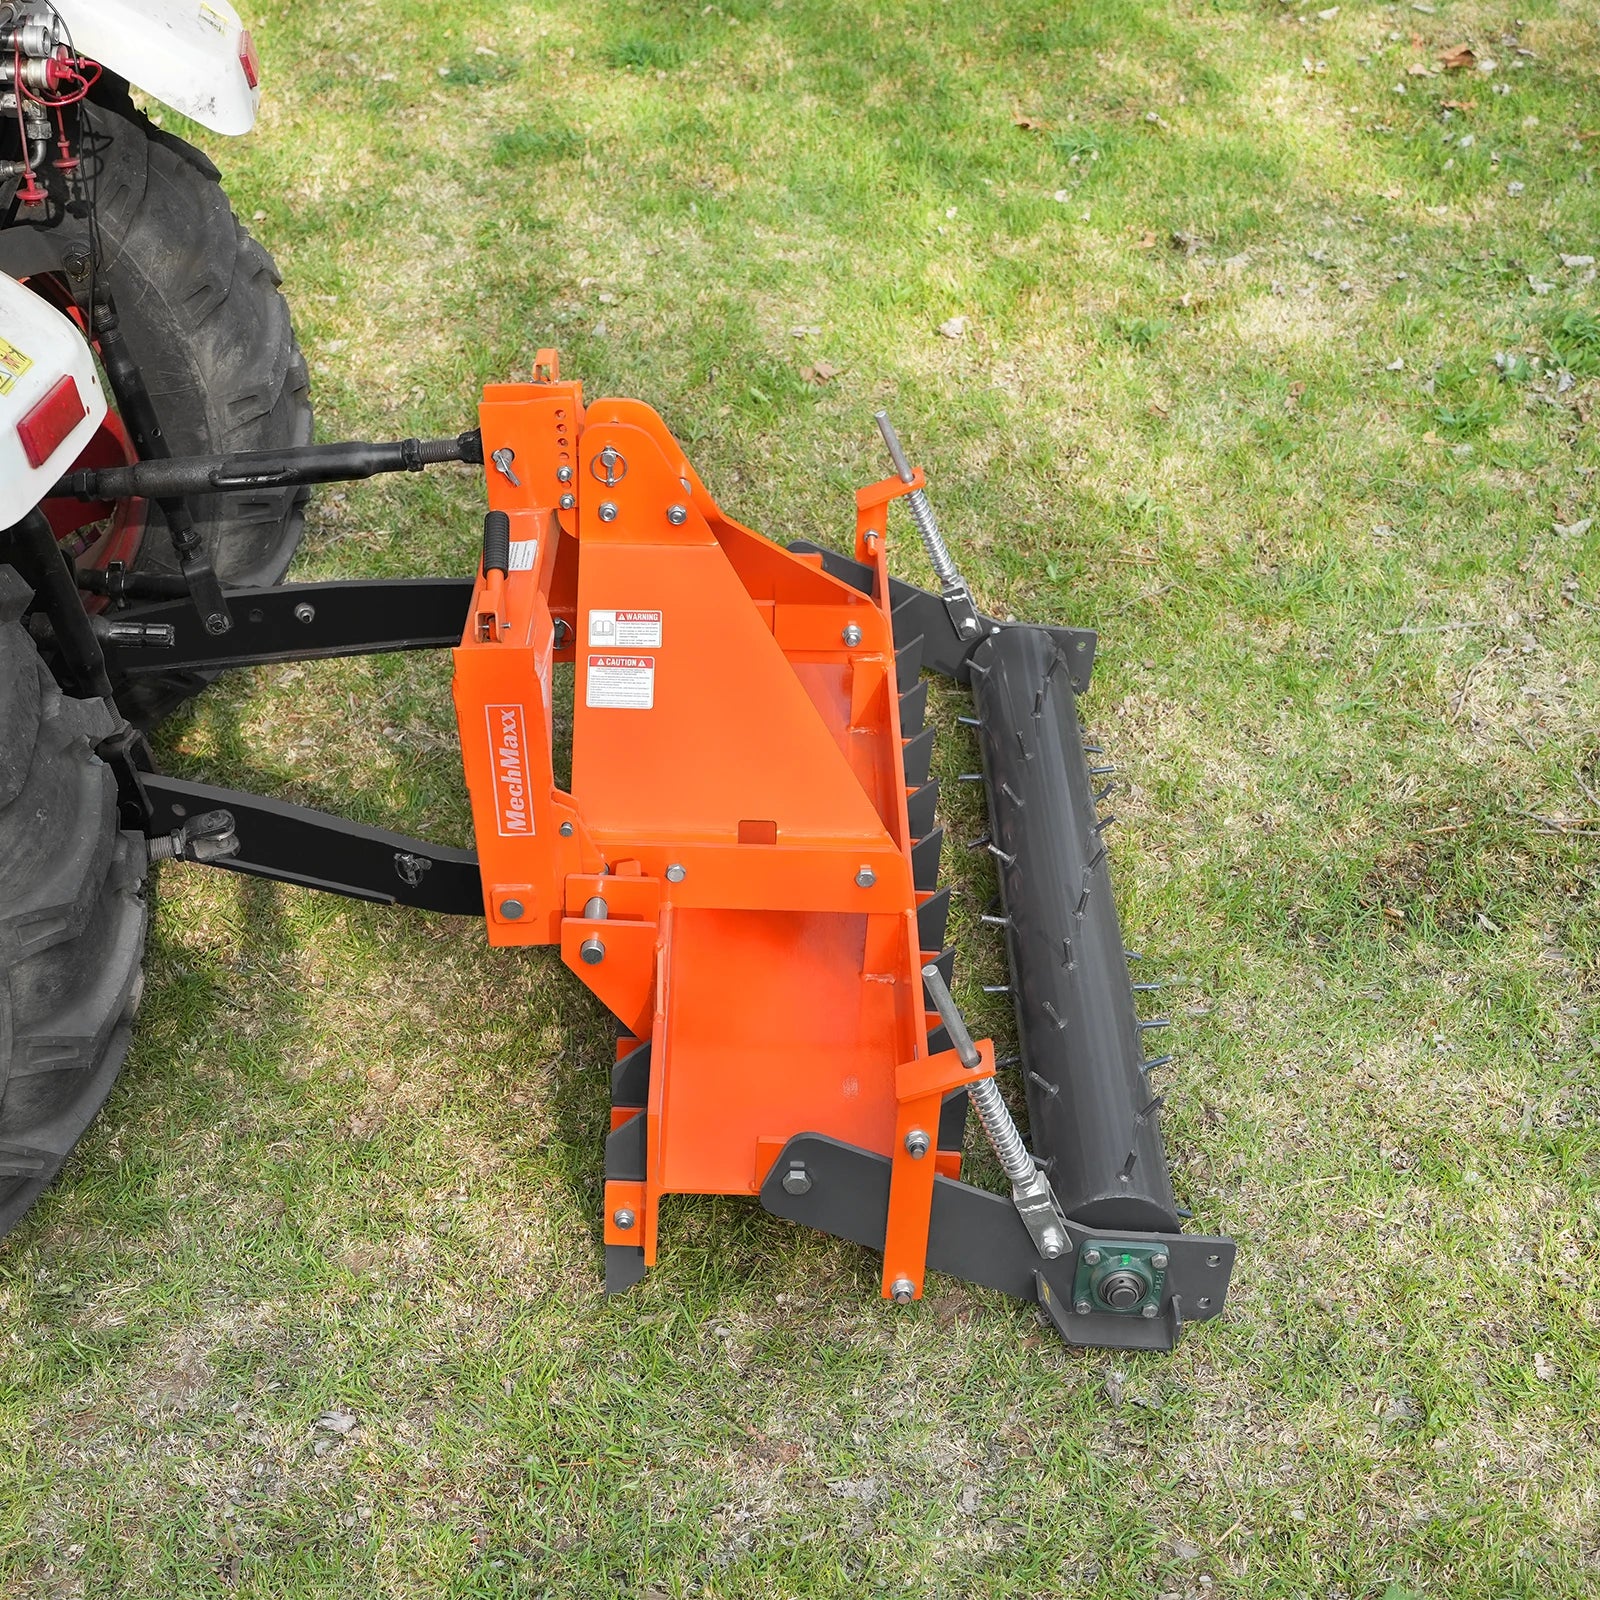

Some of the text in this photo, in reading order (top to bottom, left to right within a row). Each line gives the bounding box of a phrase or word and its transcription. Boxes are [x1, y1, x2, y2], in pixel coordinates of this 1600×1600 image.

[626, 613, 659, 621] WARNING
[606, 658, 637, 667] CAUTION
[498, 709, 527, 831] MechMaxx
